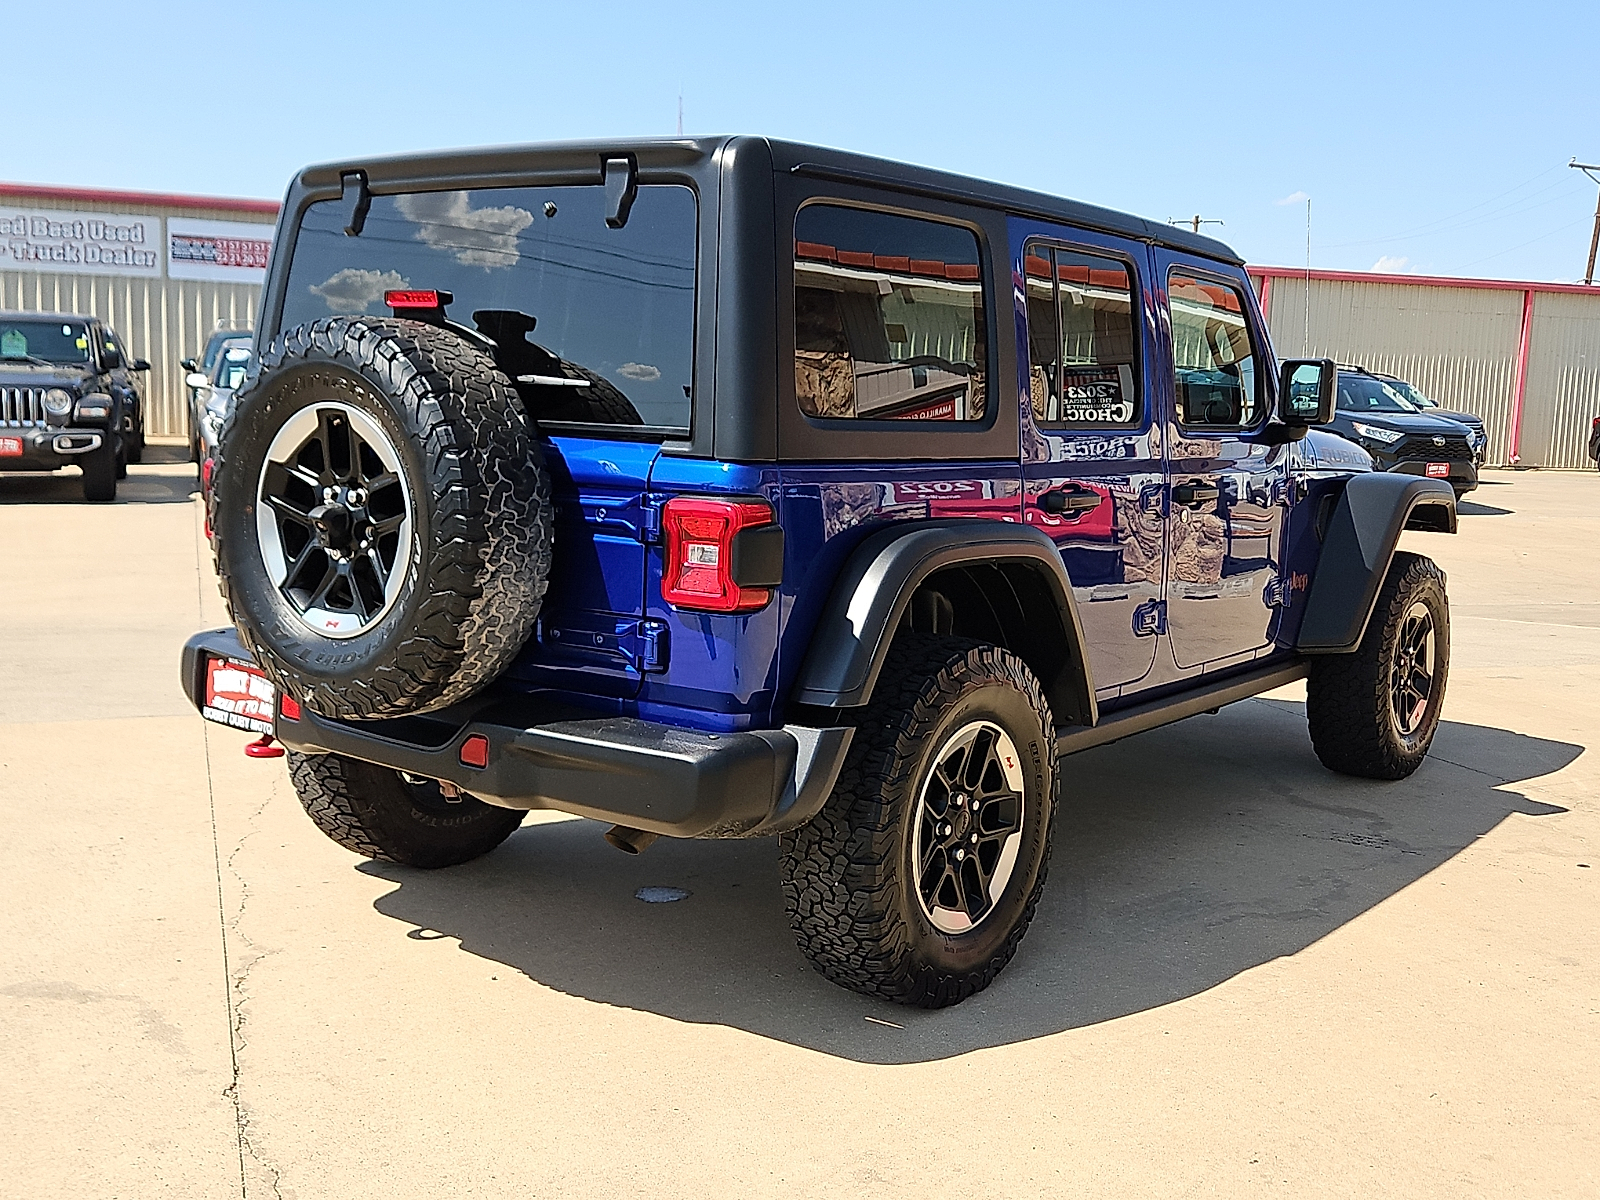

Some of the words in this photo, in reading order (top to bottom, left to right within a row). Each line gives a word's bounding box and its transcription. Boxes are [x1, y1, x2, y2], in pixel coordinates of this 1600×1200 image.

[31, 216, 83, 240] Best
[88, 220, 144, 244] Used
[9, 238, 80, 263] Truck
[84, 243, 156, 267] Dealer
[203, 706, 229, 723] BOBBY
[229, 713, 250, 729] DUBY
